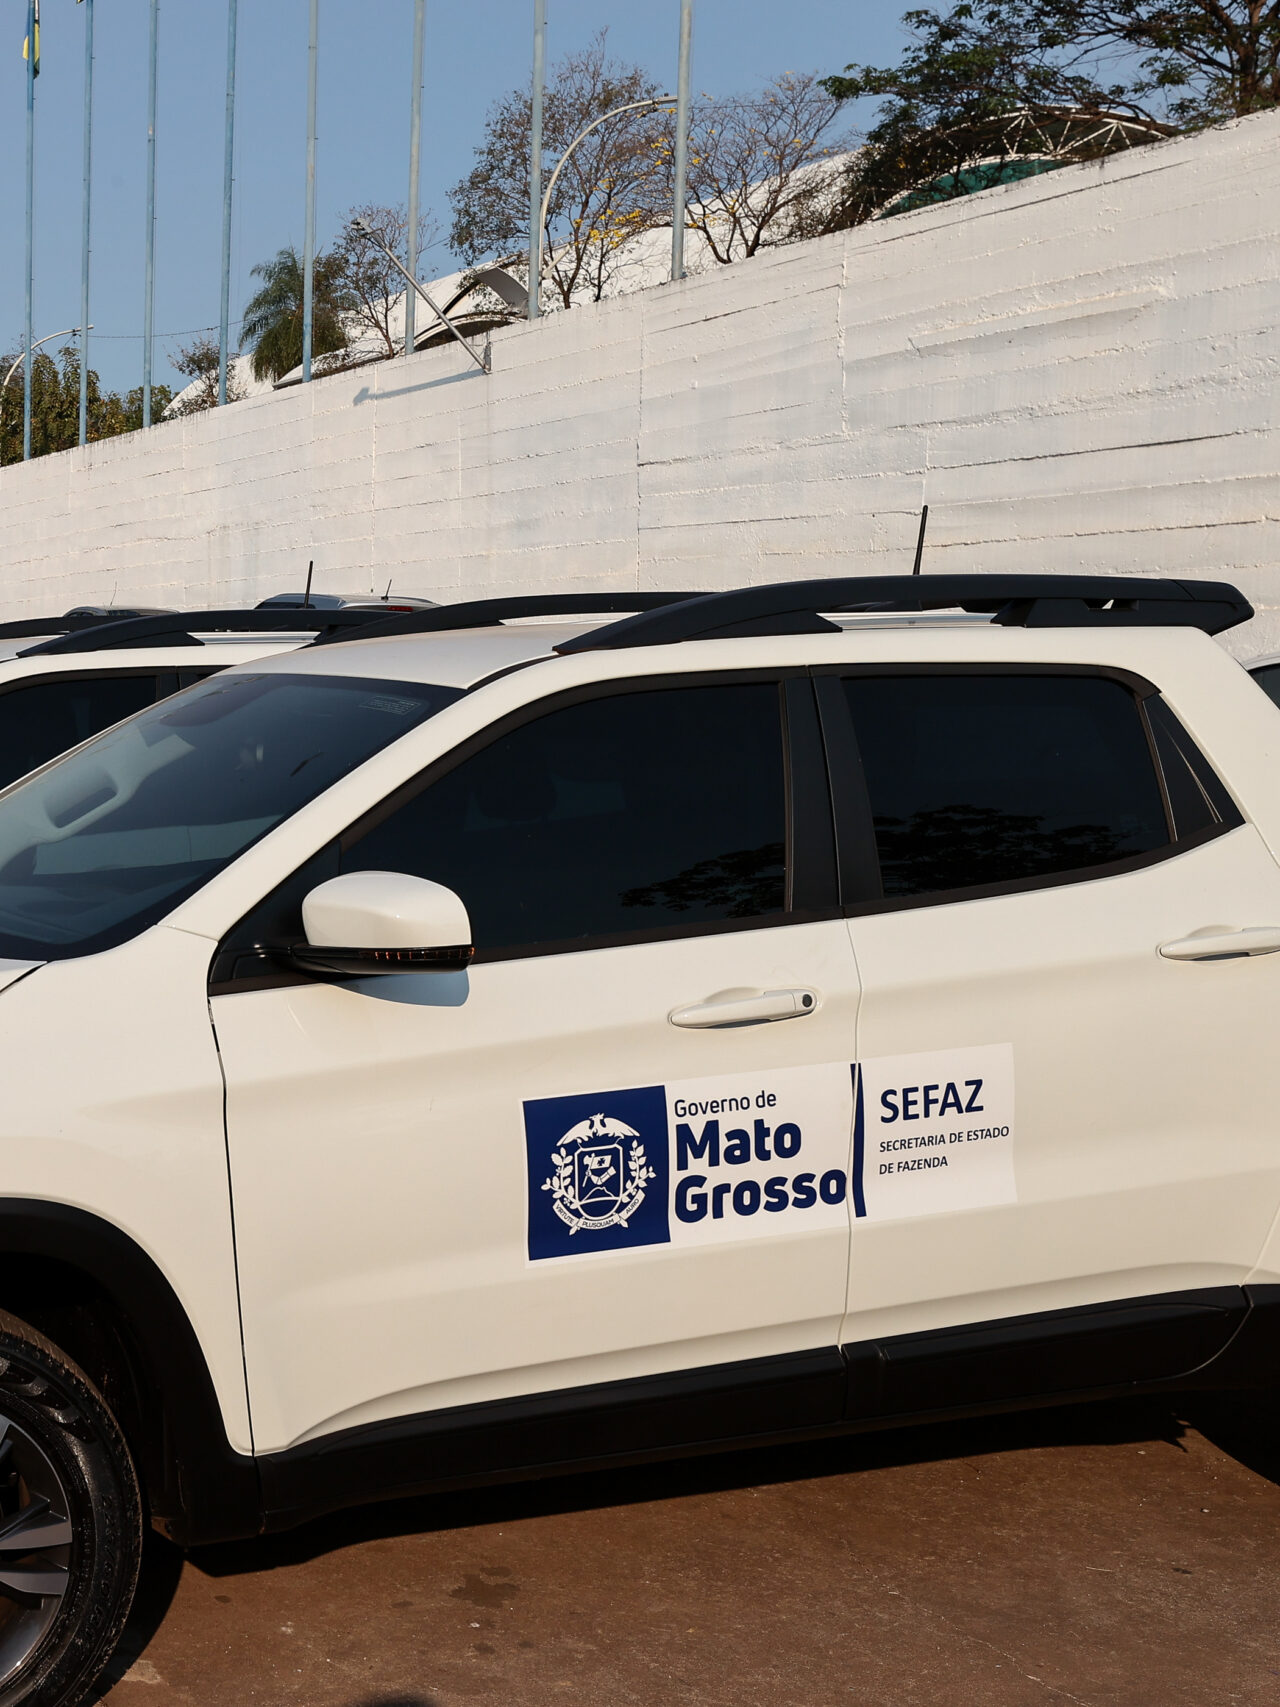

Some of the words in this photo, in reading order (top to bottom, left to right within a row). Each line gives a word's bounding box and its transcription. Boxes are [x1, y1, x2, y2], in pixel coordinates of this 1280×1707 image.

[674, 1096, 751, 1118] Governo
[755, 1090, 777, 1109] de
[880, 1079, 984, 1124] SEFAZ
[675, 1118, 802, 1171] Mato
[879, 1133, 946, 1153] SECRETARIA
[949, 1131, 964, 1144] DE
[966, 1126, 1010, 1142] ESTADO
[879, 1162, 894, 1175] DE
[897, 1156, 949, 1173] FAZENDA
[675, 1169, 847, 1223] Grosso
[555, 1204, 575, 1224] VIRTUTE
[625, 1198, 640, 1215] AURO
